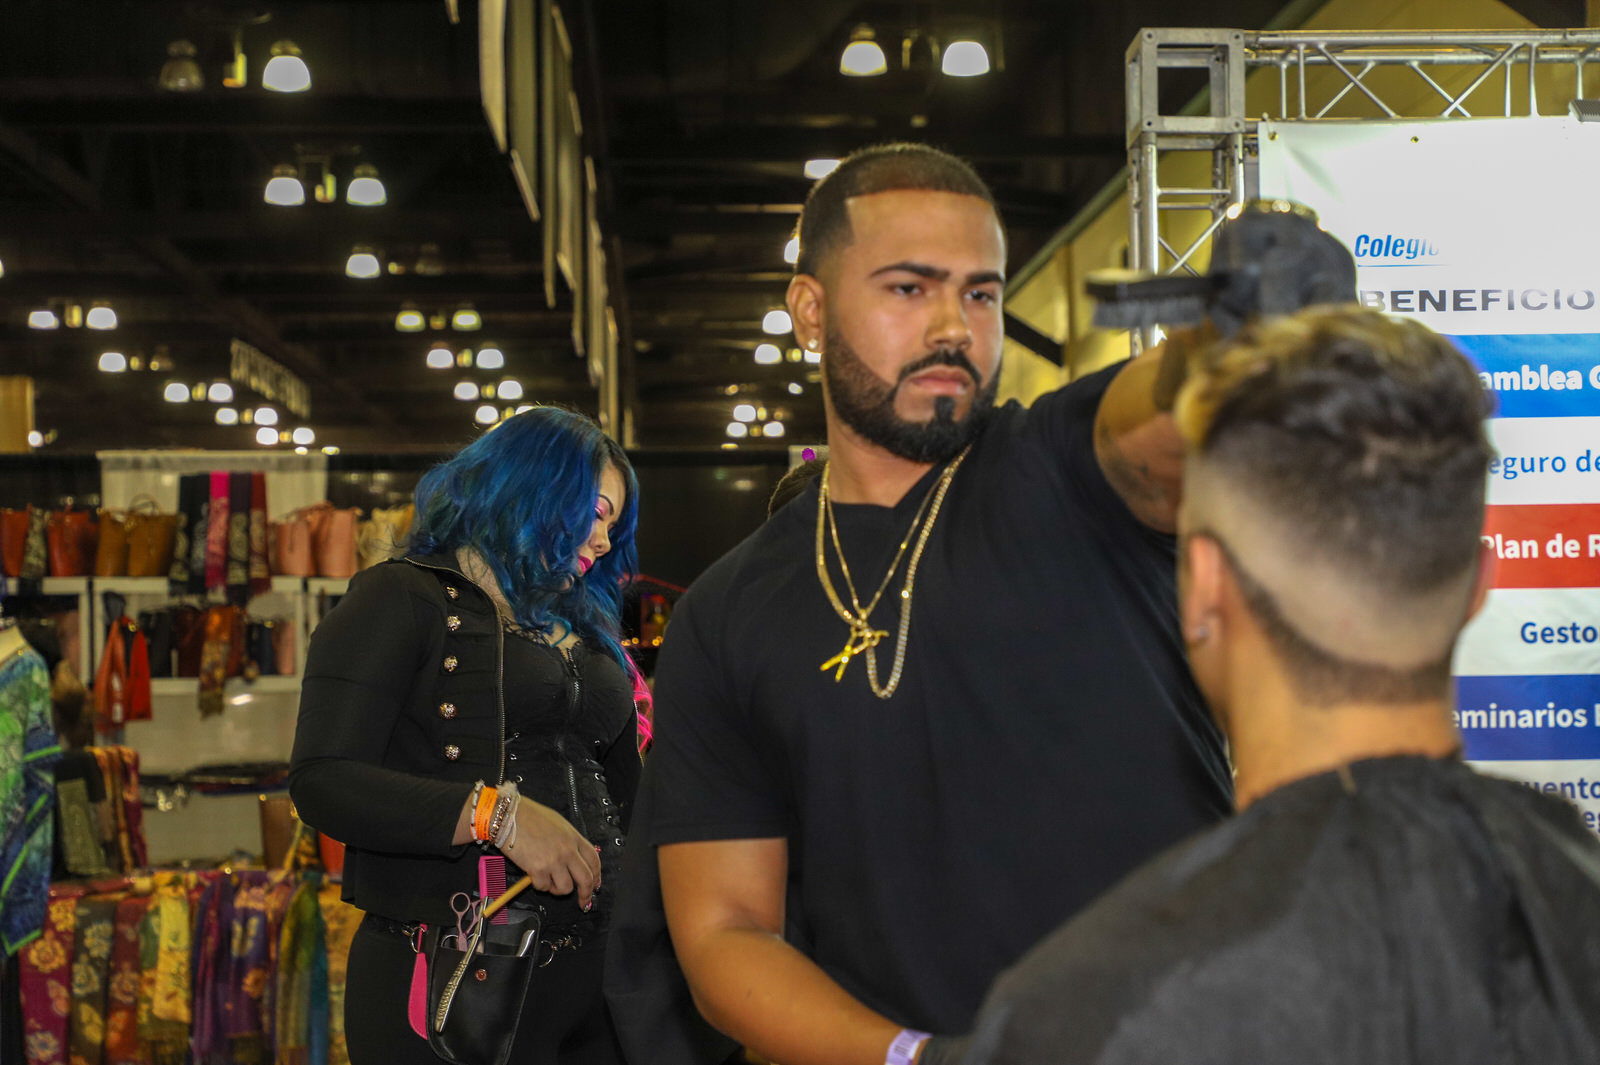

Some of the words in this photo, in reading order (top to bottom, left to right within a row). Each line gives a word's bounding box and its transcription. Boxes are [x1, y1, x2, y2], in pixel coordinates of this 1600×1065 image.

[1360, 288, 1596, 312] BENEFICIO
[1478, 364, 1582, 390] amblea
[1488, 456, 1566, 480] eguro
[1546, 533, 1580, 558] de
[1521, 622, 1598, 644] Gesto
